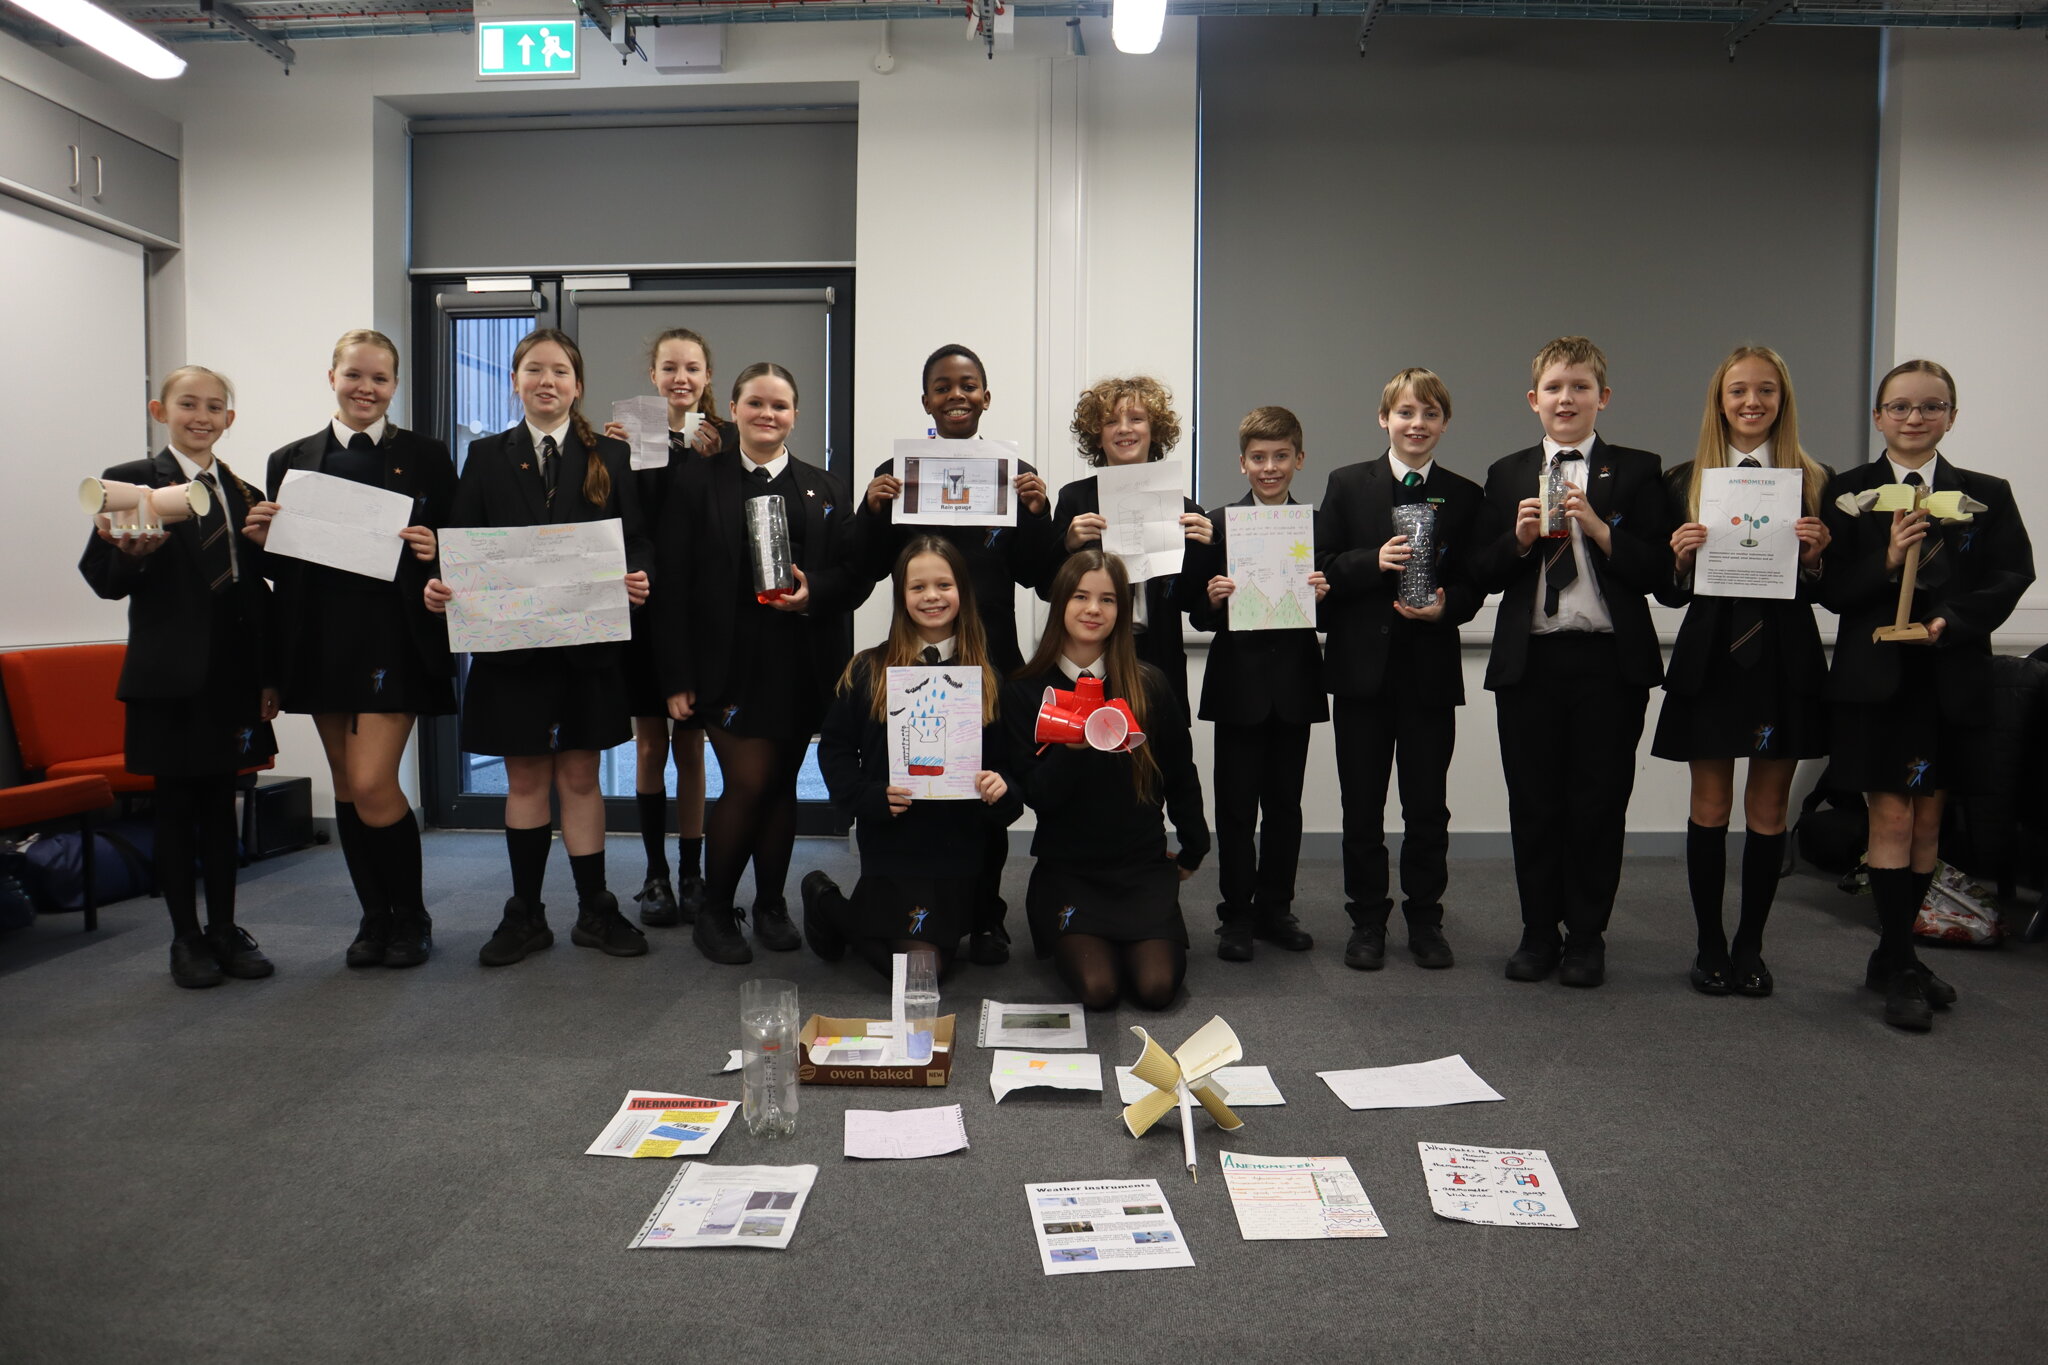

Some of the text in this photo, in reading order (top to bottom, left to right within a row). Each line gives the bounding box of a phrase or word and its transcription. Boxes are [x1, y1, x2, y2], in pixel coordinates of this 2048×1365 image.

[1282, 509, 1311, 520] TOOLS
[830, 1068, 913, 1080] oven baked
[631, 1099, 718, 1109] THERMOMETER
[1036, 1183, 1151, 1193] Weather instruments
